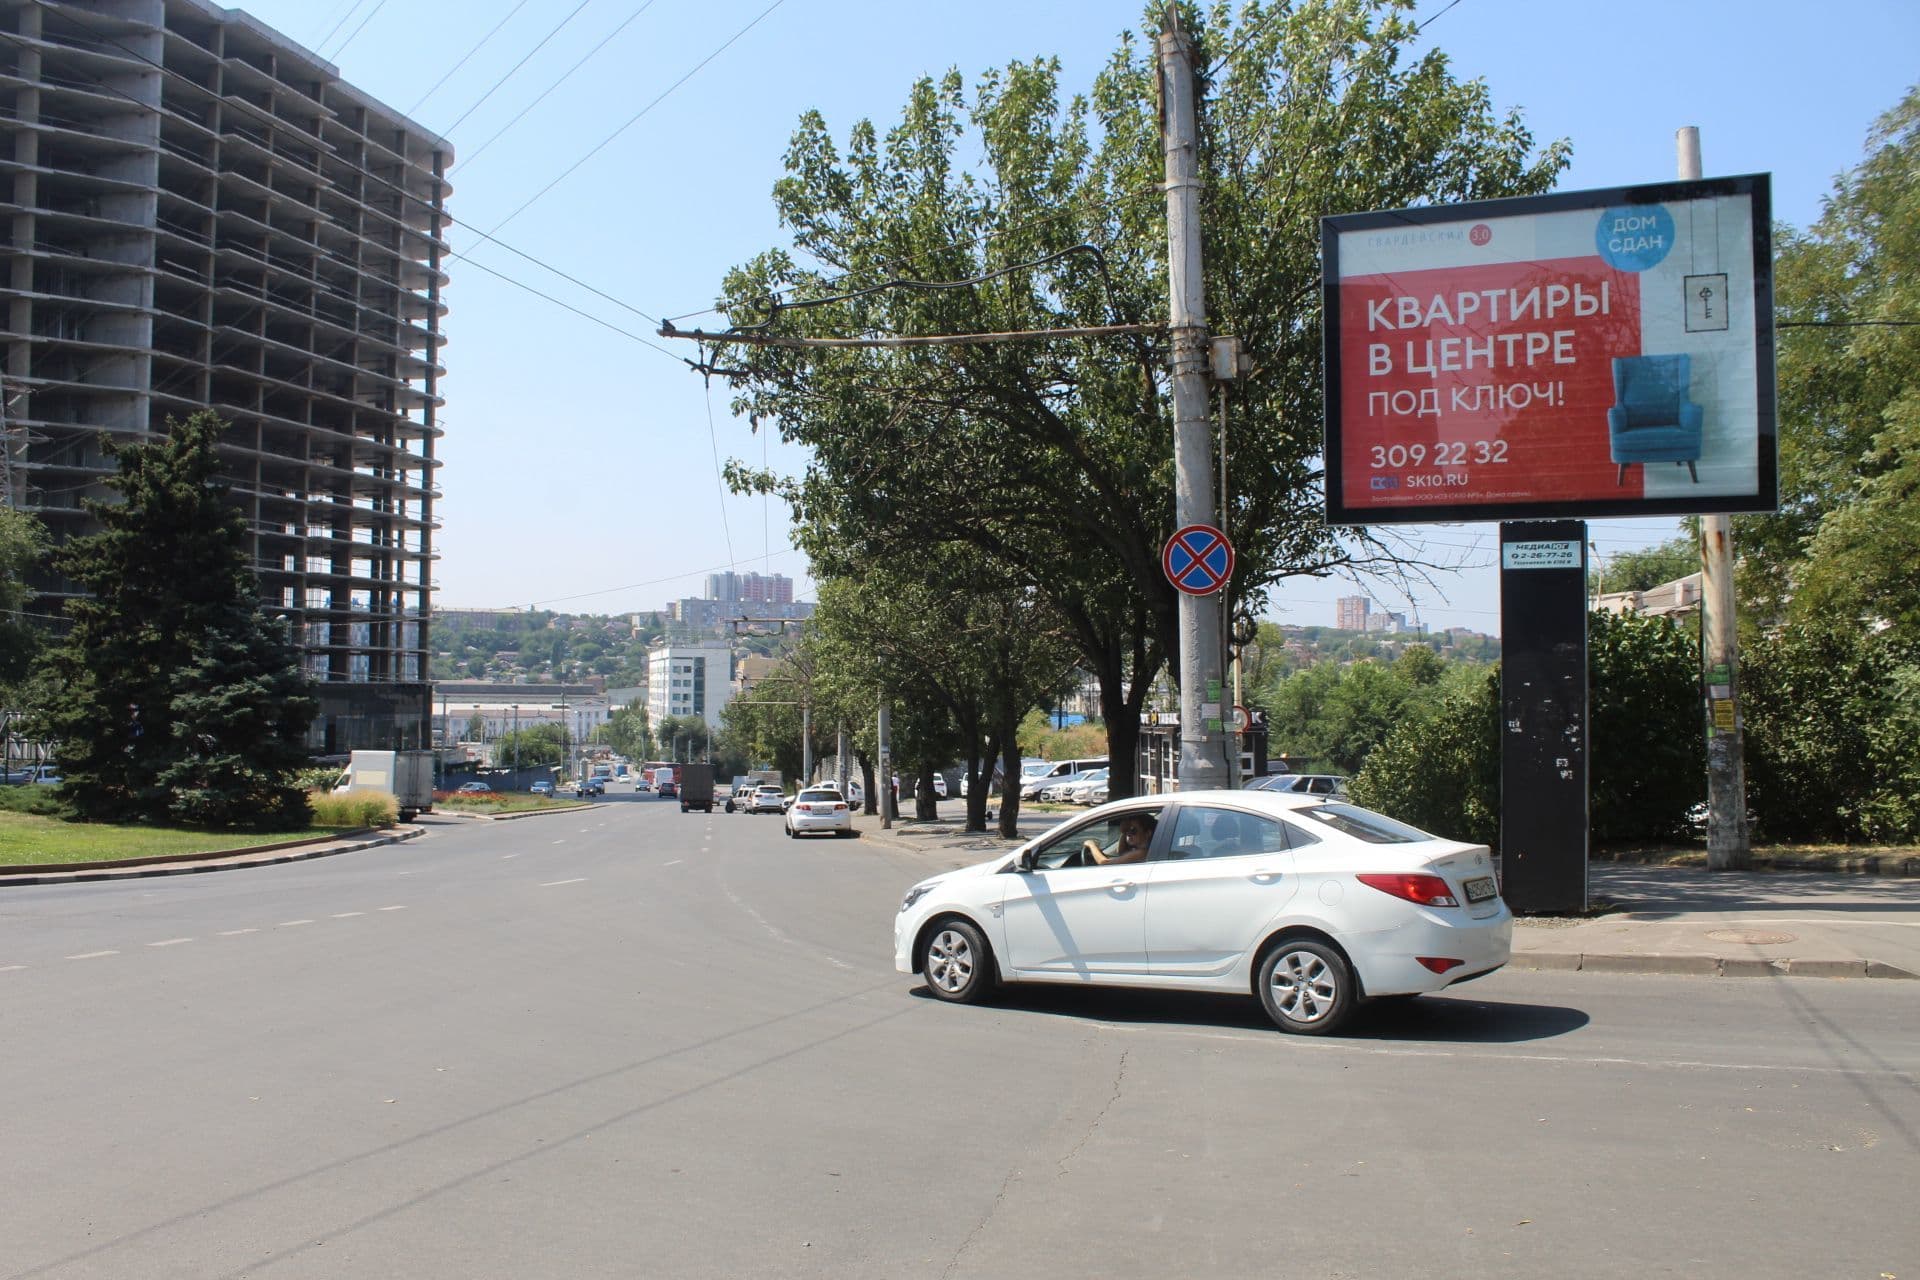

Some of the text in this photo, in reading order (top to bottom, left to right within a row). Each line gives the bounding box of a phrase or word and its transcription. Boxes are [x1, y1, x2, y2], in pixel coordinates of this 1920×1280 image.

[1613, 216, 1656, 234] ДОМ
[1608, 234, 1663, 253] СДАН
[1368, 281, 1609, 331] КВАРТИРЫ
[1369, 330, 1576, 378] В ЦЕНТРЕ
[1369, 381, 1565, 418] ПОД КЛЮЧ!
[1370, 440, 1508, 468] 309 22 32
[1407, 473, 1469, 488] SK10.RU
